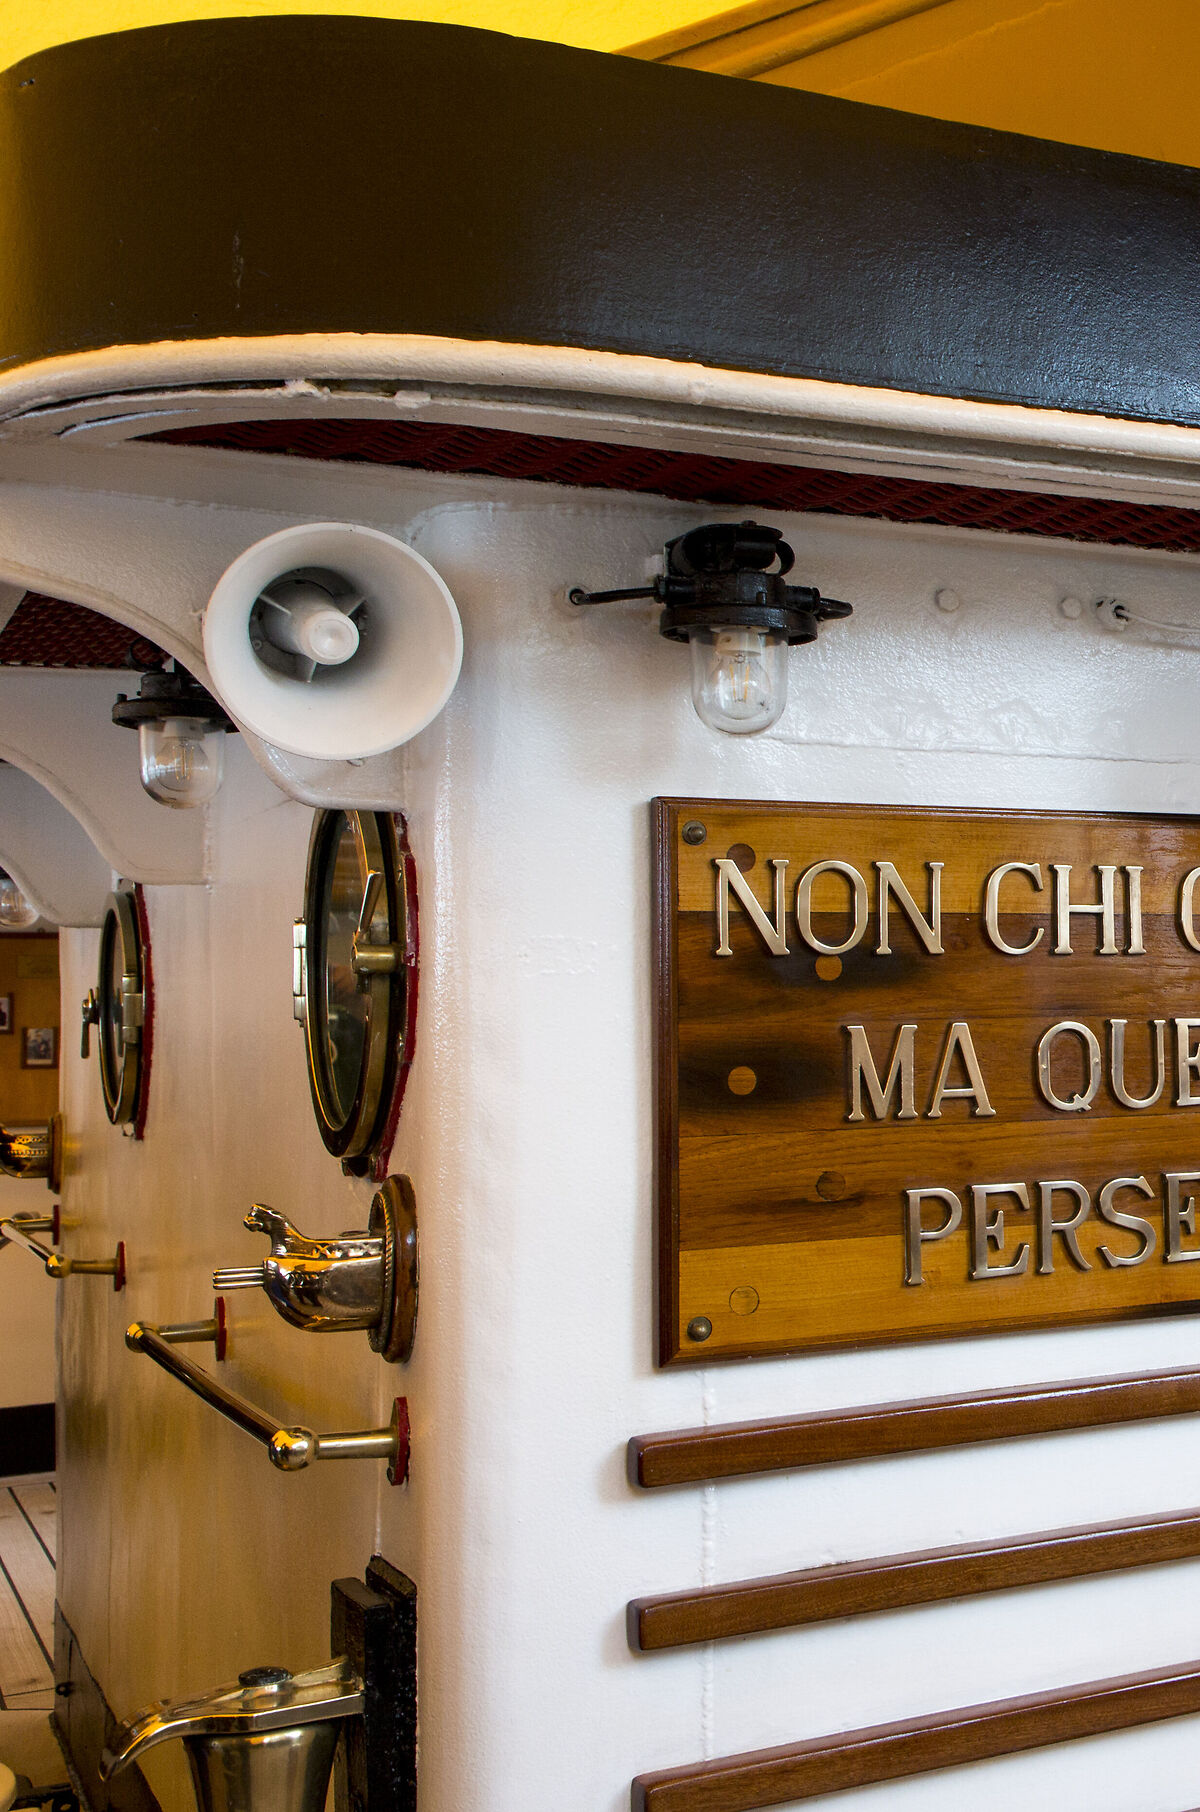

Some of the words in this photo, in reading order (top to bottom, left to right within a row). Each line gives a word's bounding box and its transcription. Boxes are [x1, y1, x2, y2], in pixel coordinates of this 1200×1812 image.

[714, 858, 946, 956] NON
[984, 862, 1147, 955] CHI
[844, 1022, 997, 1121] MA
